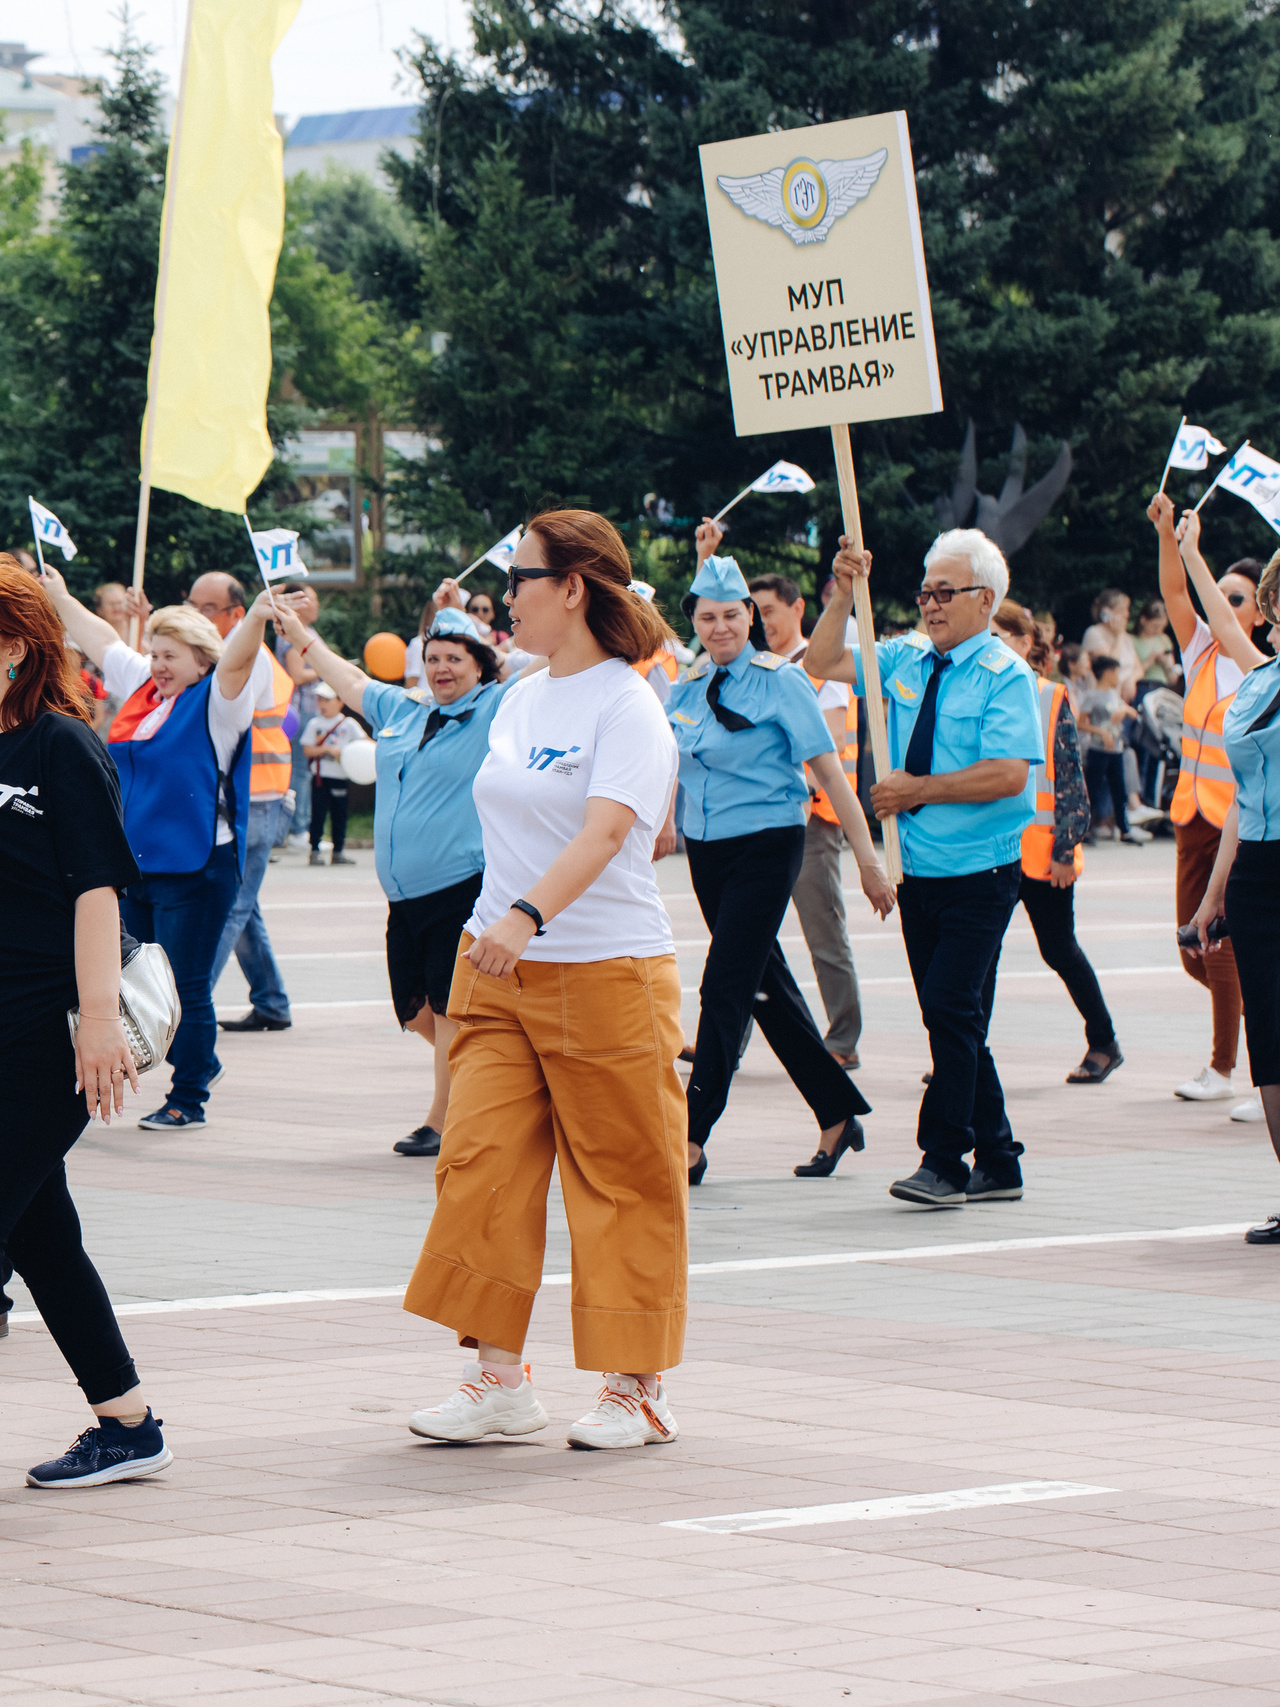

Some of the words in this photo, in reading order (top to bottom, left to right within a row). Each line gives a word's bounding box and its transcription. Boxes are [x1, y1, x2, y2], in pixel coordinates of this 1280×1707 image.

[786, 278, 845, 312] МУП
[729, 311, 916, 361] «УПРАВЛЕНИЕ
[758, 359, 895, 401] ТРАМВАЯ»
